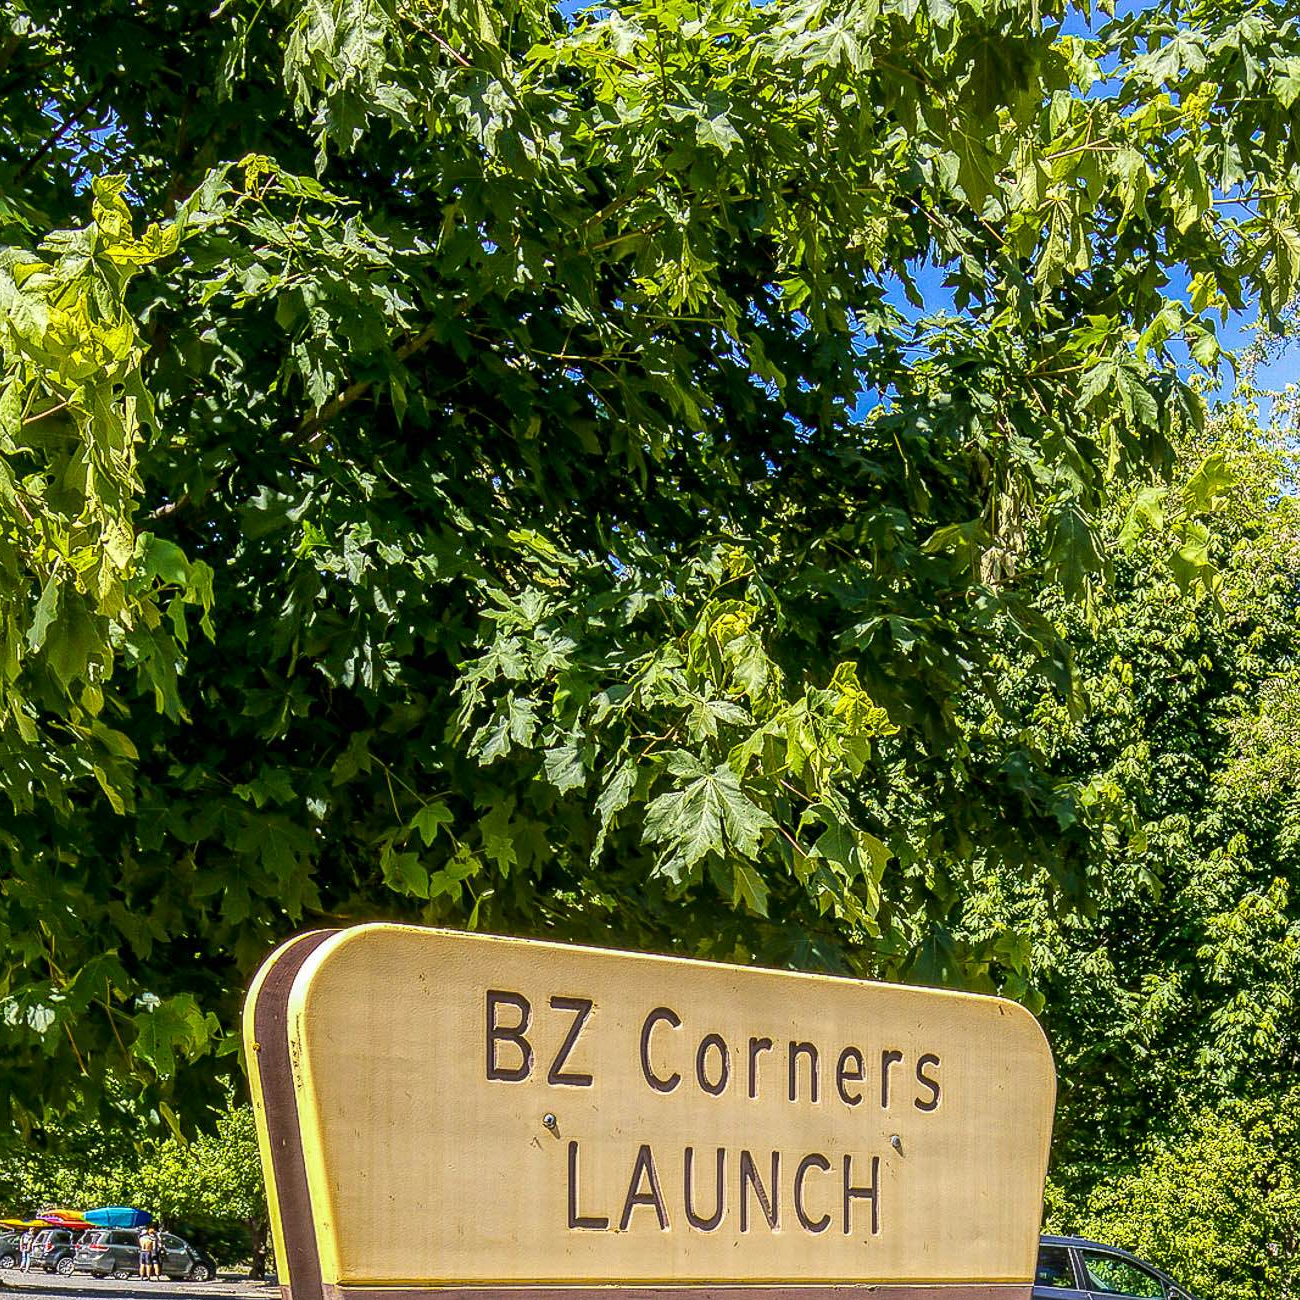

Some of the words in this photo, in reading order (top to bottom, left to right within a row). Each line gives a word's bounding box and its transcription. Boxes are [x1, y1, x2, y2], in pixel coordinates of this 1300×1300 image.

[485, 989, 593, 1087] BZ
[640, 1007, 942, 1112] Corners
[567, 1140, 881, 1236] LAUNCH
